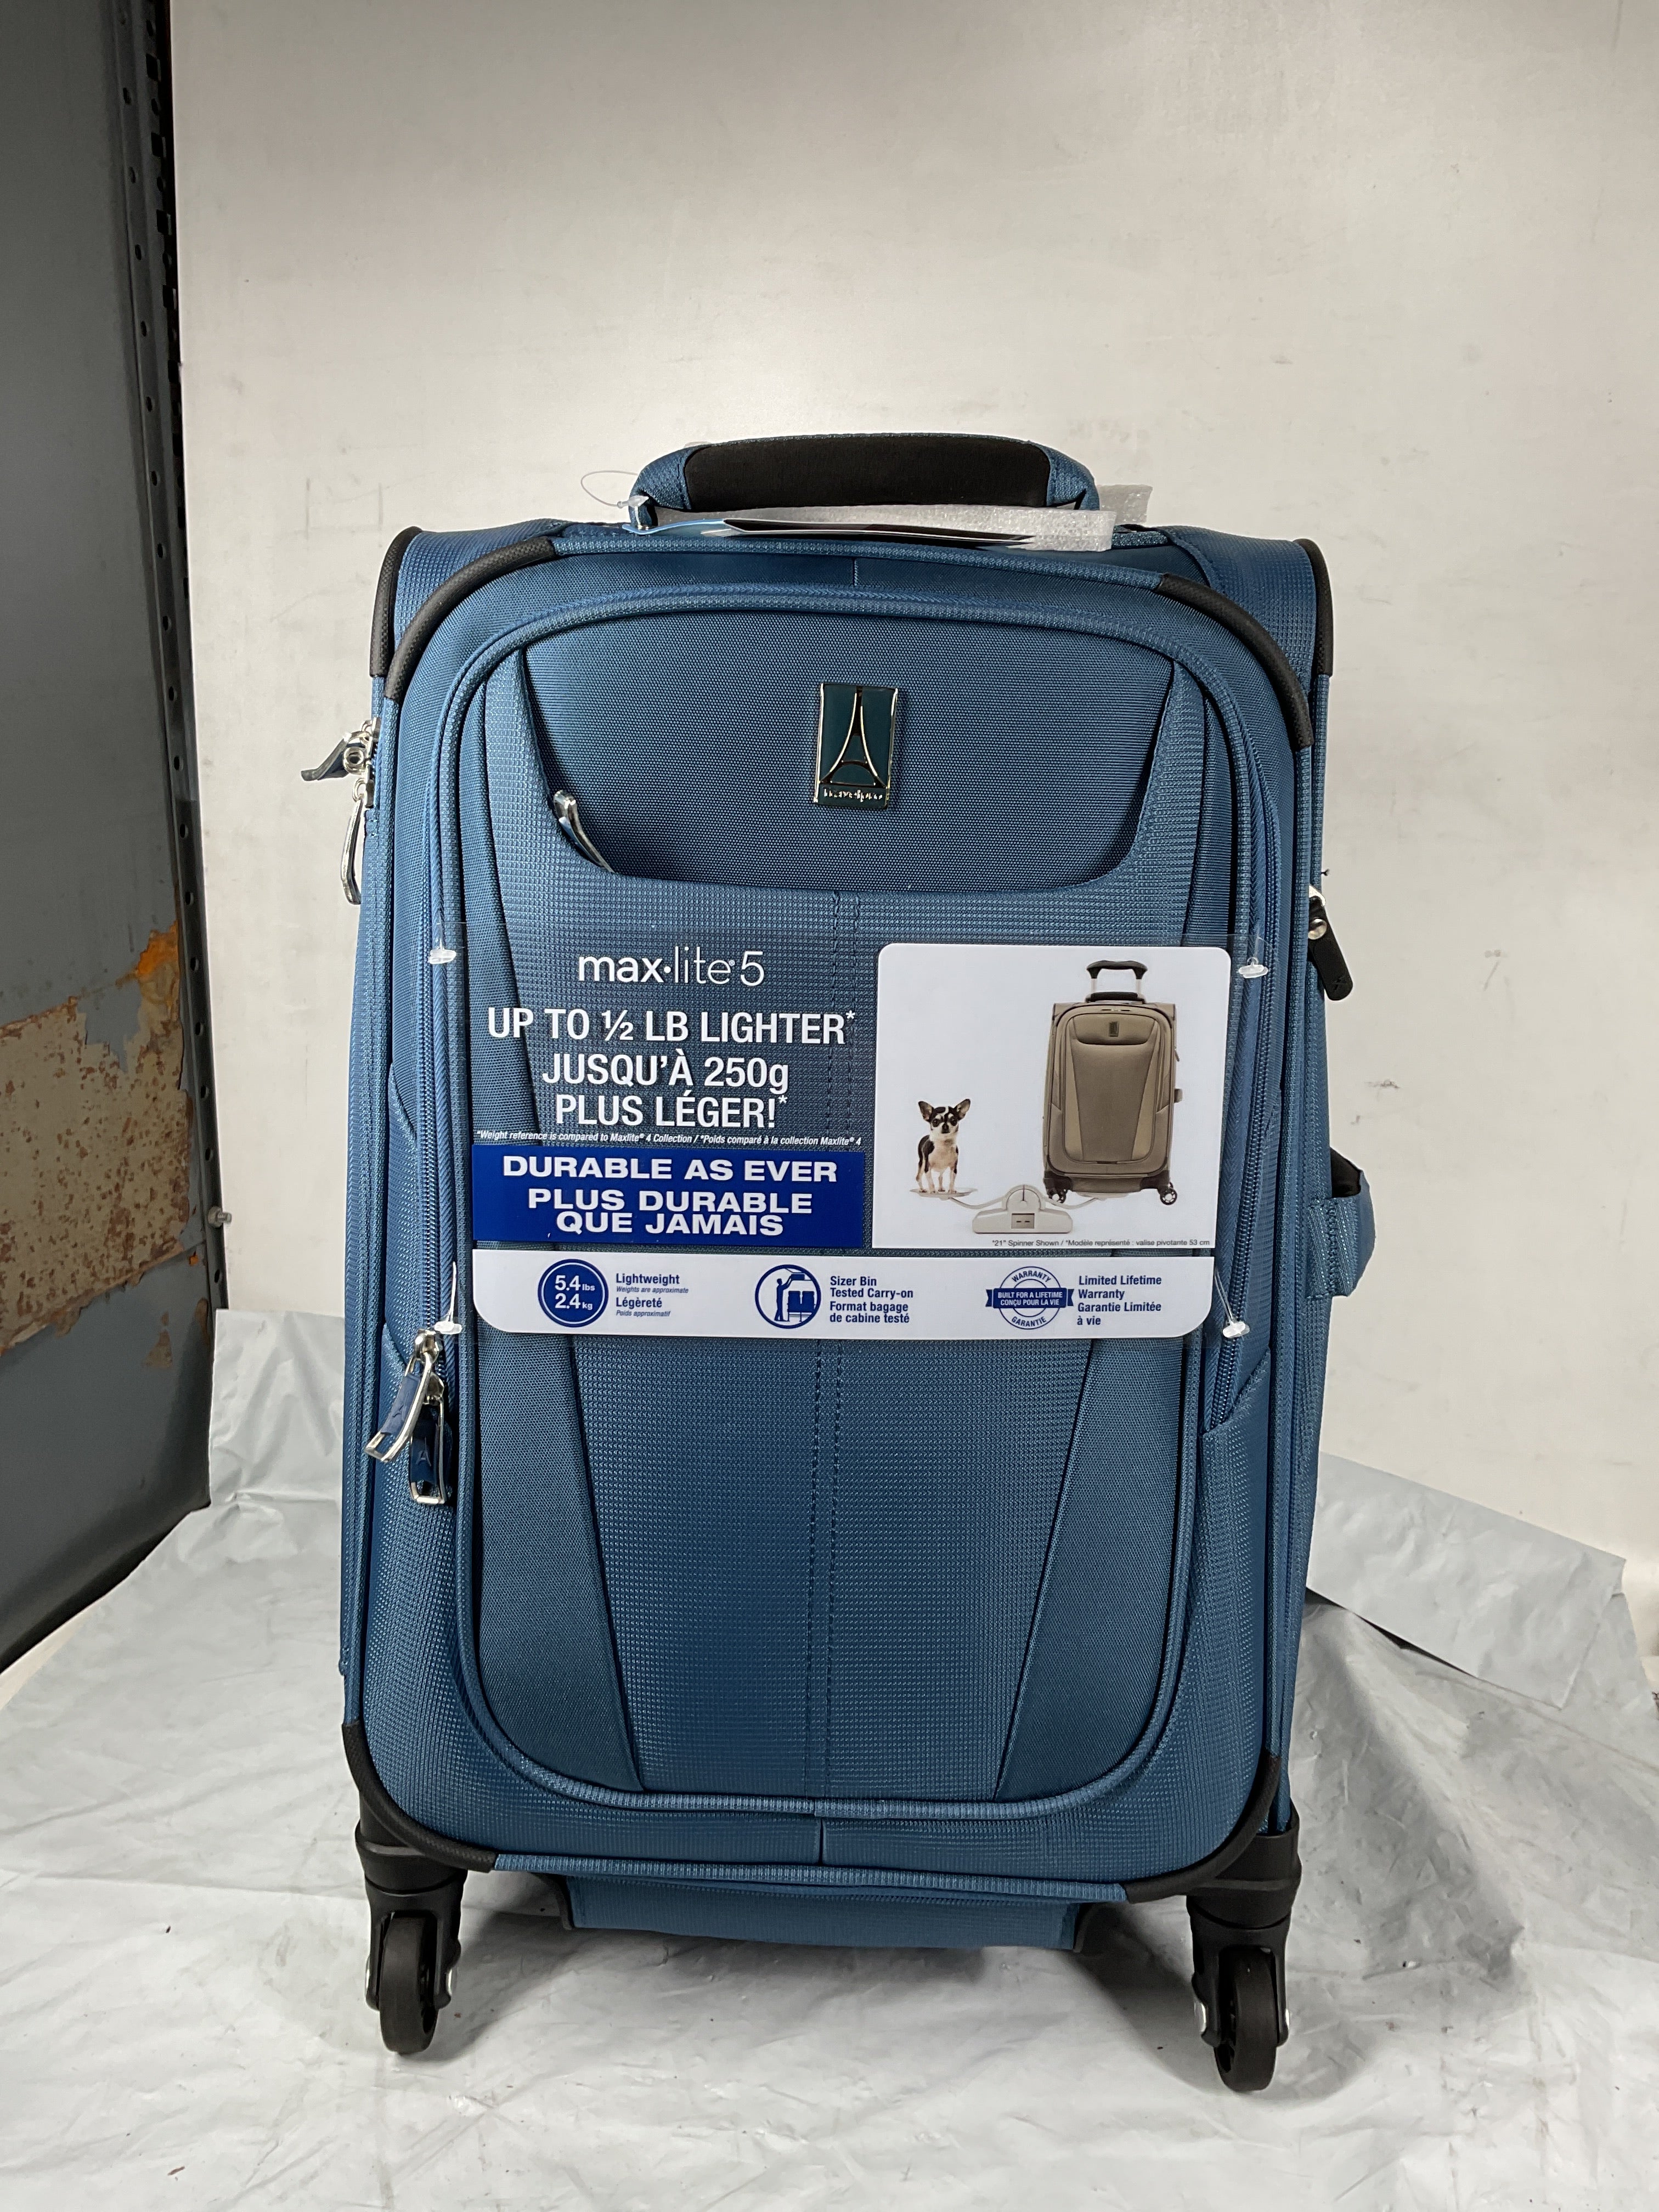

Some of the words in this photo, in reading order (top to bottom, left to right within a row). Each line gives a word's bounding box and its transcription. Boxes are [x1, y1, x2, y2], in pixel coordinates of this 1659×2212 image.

[740, 951, 764, 986] 5
[488, 1007, 533, 1039] UP
[544, 1008, 590, 1041] TO
[646, 1010, 689, 1042] LB
[704, 1057, 789, 1094] 250g
[556, 1094, 644, 1126] PLUS
[509, 1132, 548, 1141] reference
[549, 1133, 557, 1141] is
[559, 1133, 598, 1142] compared
[646, 1134, 651, 1142] 4
[653, 1134, 692, 1143] Collection
[694, 1135, 699, 1143] /
[727, 1136, 761, 1146] comparé
[763, 1136, 769, 1144] à
[770, 1136, 778, 1145] la
[780, 1137, 819, 1146] collection
[856, 1138, 861, 1146] 4
[503, 1155, 672, 1180] DURABLE
[684, 1159, 734, 1181] AS
[744, 1160, 838, 1183] EVER
[528, 1188, 625, 1211] PLUS
[639, 1190, 812, 1214] DURABLE
[557, 1211, 633, 1235] QUE
[645, 1212, 783, 1236] JAMAIS
[1008, 1240, 1034, 1248] Spinner
[1095, 1240, 1130, 1248] représenté
[1156, 1240, 1187, 1248] pivotante
[555, 1275, 581, 1291] 5.4
[616, 1273, 680, 1286] Lightweight
[830, 1276, 856, 1286] Sizer
[860, 1277, 877, 1286] Bin
[1012, 1270, 1052, 1283] WARRANTY
[1079, 1276, 1117, 1285] Limited
[1120, 1276, 1161, 1285] Lifetime
[830, 1288, 864, 1297] Tested
[867, 1288, 913, 1300] Carry-on
[1079, 1289, 1125, 1300] Warranty
[555, 1293, 581, 1309] 2.4
[582, 1302, 593, 1311] kg
[616, 1297, 662, 1310] Légèreté
[830, 1301, 867, 1311] Format
[870, 1302, 909, 1313] bagage
[1000, 1299, 1022, 1307] CONÇU
[1077, 1302, 1121, 1312] Garantie
[1125, 1302, 1161, 1312] Limitée
[830, 1313, 842, 1323] de
[845, 1313, 880, 1323] cabine
[884, 1313, 910, 1323] testé
[1011, 1316, 1047, 1327] GARANTIE
[1077, 1316, 1083, 1325] à
[1086, 1316, 1101, 1325] vie
